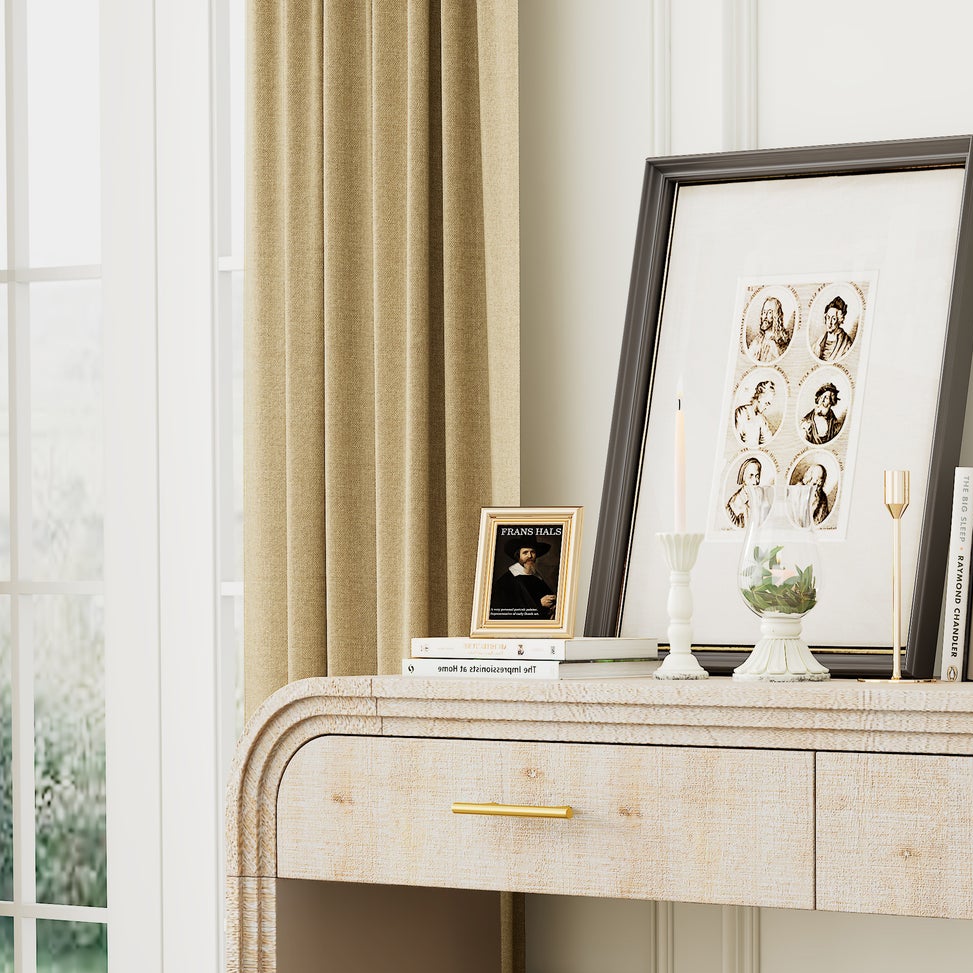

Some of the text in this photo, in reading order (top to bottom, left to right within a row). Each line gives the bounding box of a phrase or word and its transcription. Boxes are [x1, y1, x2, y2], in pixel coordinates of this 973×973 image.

[501, 527, 562, 536] FRANS HALS
[951, 555, 964, 658] RAYMOND CHANDLER
